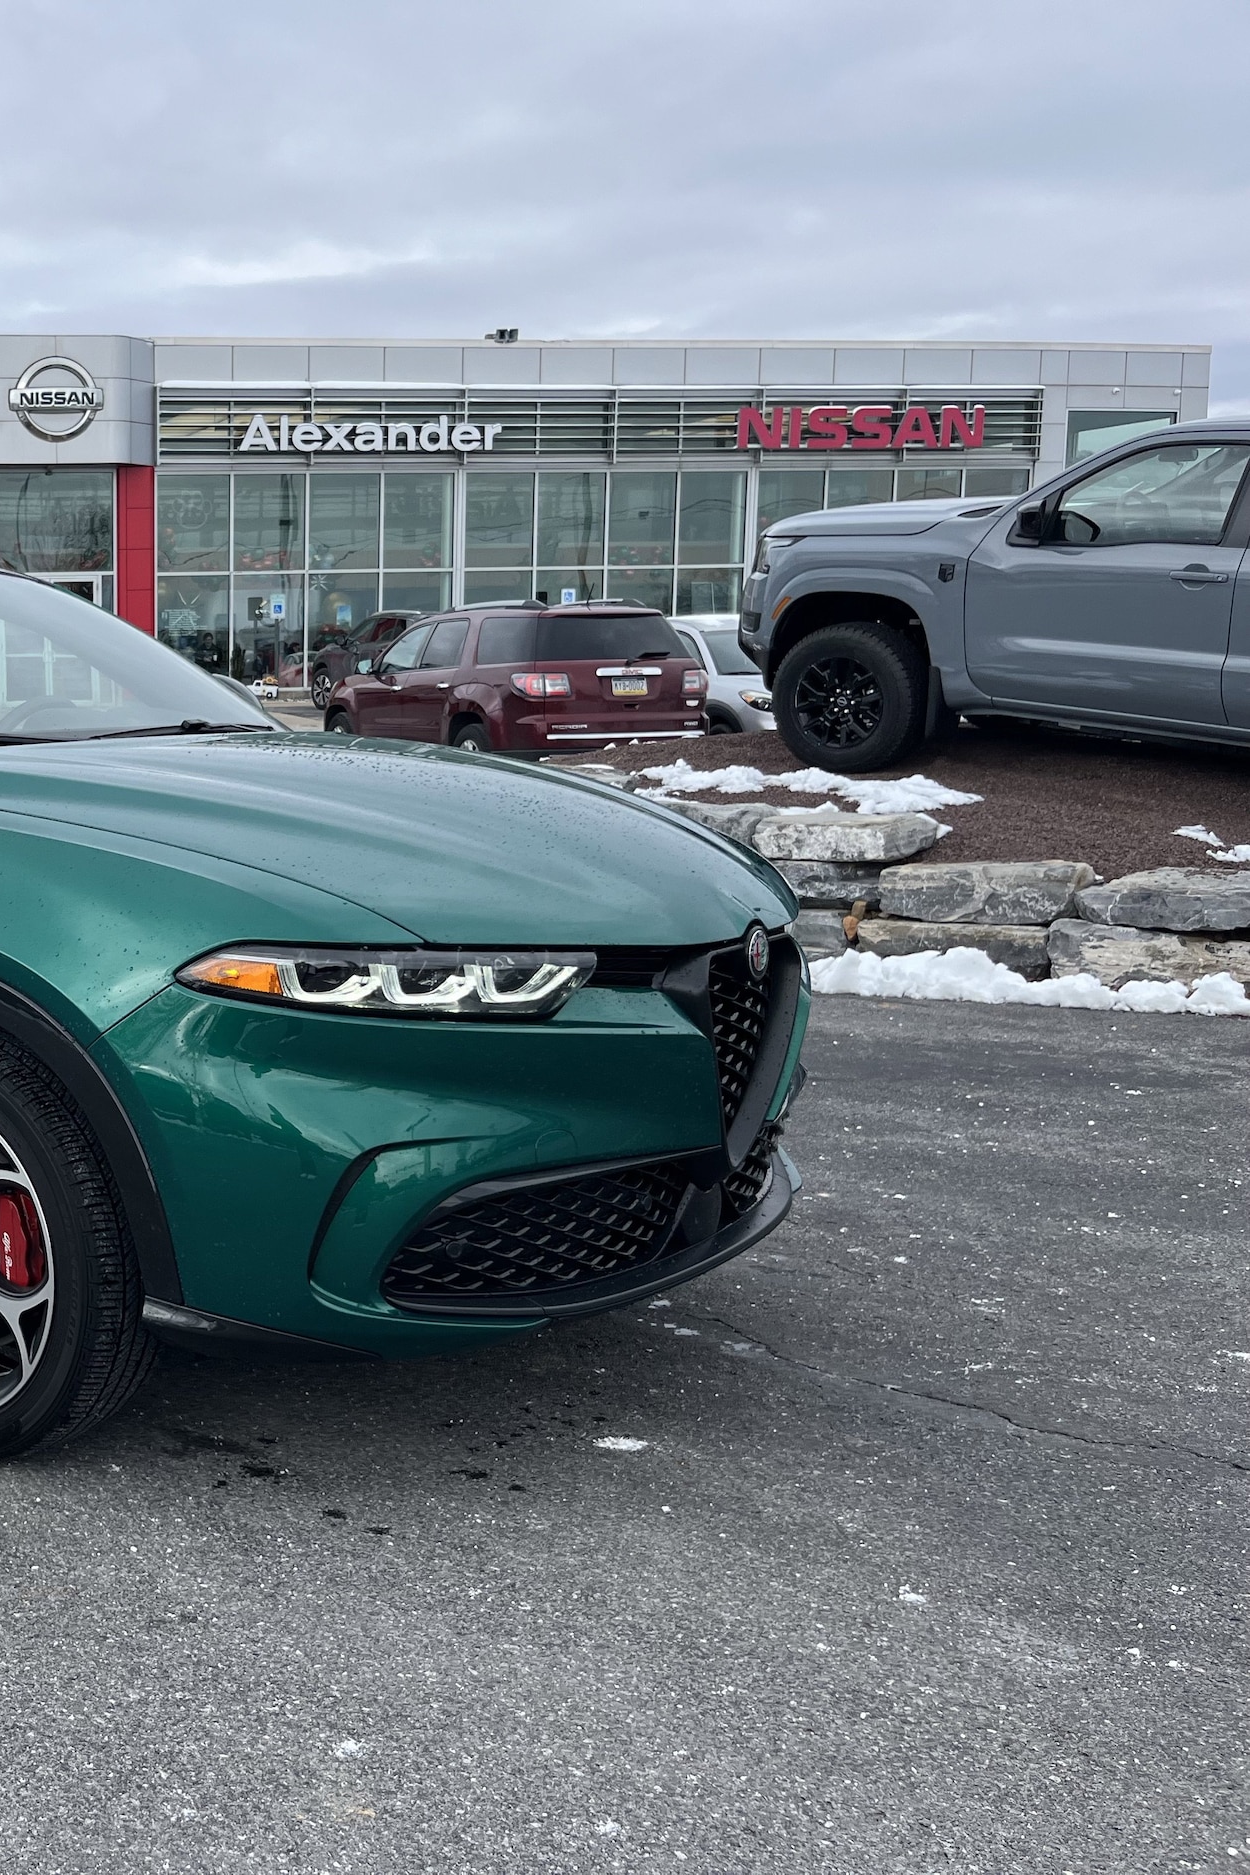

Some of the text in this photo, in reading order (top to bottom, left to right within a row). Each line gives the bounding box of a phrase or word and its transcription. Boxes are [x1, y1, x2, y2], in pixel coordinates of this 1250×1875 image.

[19, 392, 94, 406] NISSAN
[238, 414, 502, 452] Alexander
[736, 405, 985, 449] NISSAN
